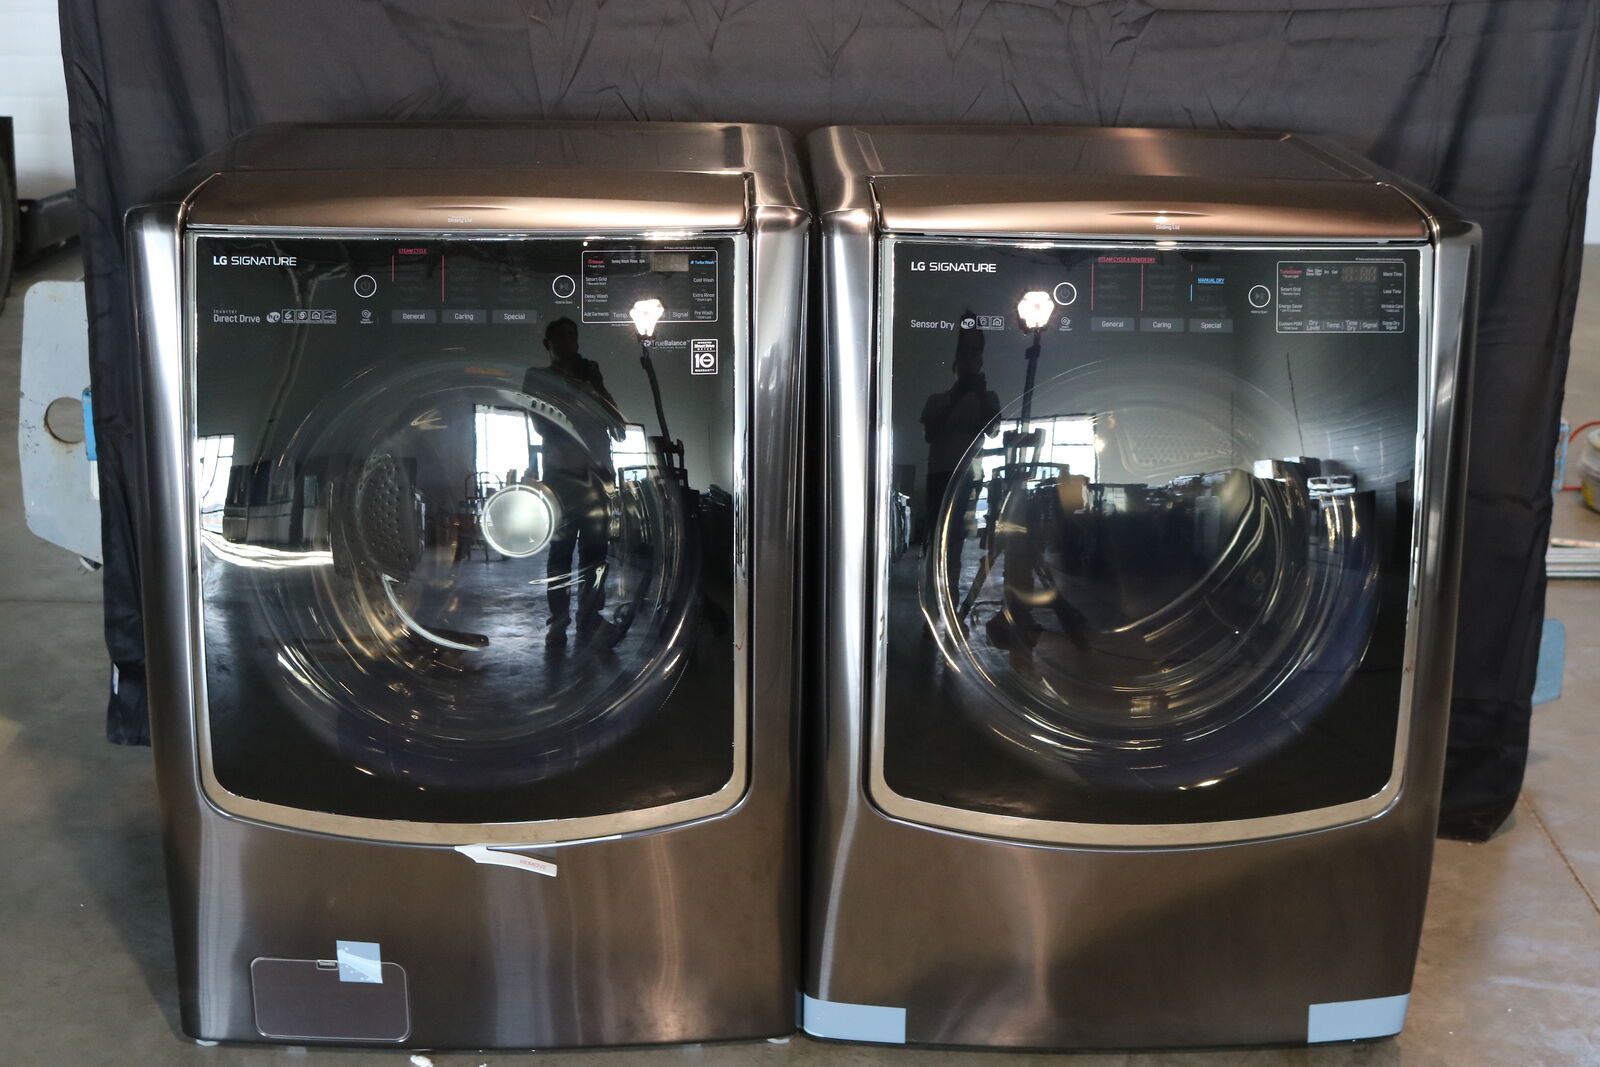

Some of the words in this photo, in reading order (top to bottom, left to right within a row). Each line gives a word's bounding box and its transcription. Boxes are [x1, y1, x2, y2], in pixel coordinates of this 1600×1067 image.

[212, 255, 228, 266] LG
[230, 255, 298, 267] SIGNATURE
[910, 261, 926, 271] LG
[929, 261, 997, 273] SIGNATURE
[213, 314, 238, 323] Direct
[239, 314, 261, 323] Drive
[402, 311, 426, 320] General
[454, 312, 475, 322] Caring
[503, 312, 527, 322] Special
[672, 311, 689, 319] Signal
[910, 319, 938, 330] Sensor
[940, 320, 955, 331] Dry
[1101, 319, 1125, 328] General
[1152, 320, 1172, 330] Caring
[1200, 320, 1222, 330] Special
[694, 353, 715, 369] 10
